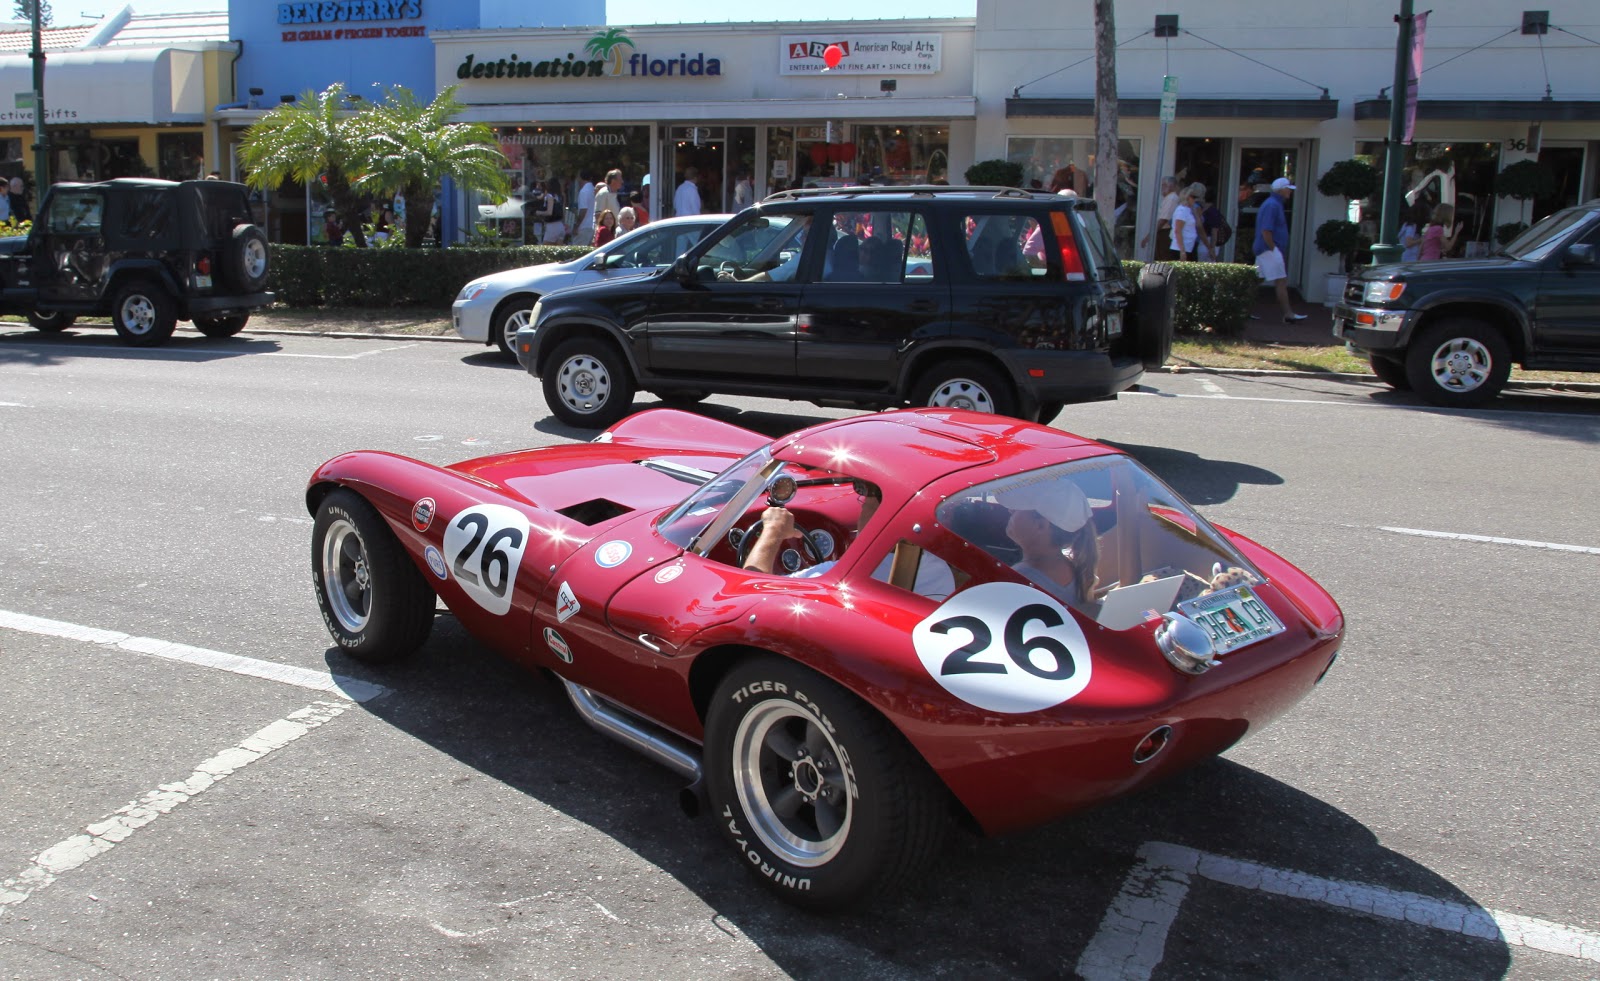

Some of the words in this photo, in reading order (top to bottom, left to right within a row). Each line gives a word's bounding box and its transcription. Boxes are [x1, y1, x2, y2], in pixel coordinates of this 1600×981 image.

[282, 31, 297, 42] ICE
[298, 29, 332, 41] CREAM
[344, 27, 382, 39] FROZEN
[384, 25, 426, 37] YOGURT
[854, 41, 888, 52] American
[891, 40, 913, 55] Royal
[915, 40, 935, 52] Arts
[456, 53, 604, 79] destination
[629, 52, 721, 77] florida
[569, 133, 627, 146] FLORIDA
[453, 512, 524, 599] 26
[1241, 599, 1272, 625] CR
[323, 611, 341, 640] PAW
[341, 633, 366, 648] TIGER
[548, 635, 568, 654] Castrol
[929, 603, 1076, 681] 26
[732, 680, 789, 704] TIGER
[794, 690, 837, 735] PAW
[723, 804, 812, 891] UNIROYAL
